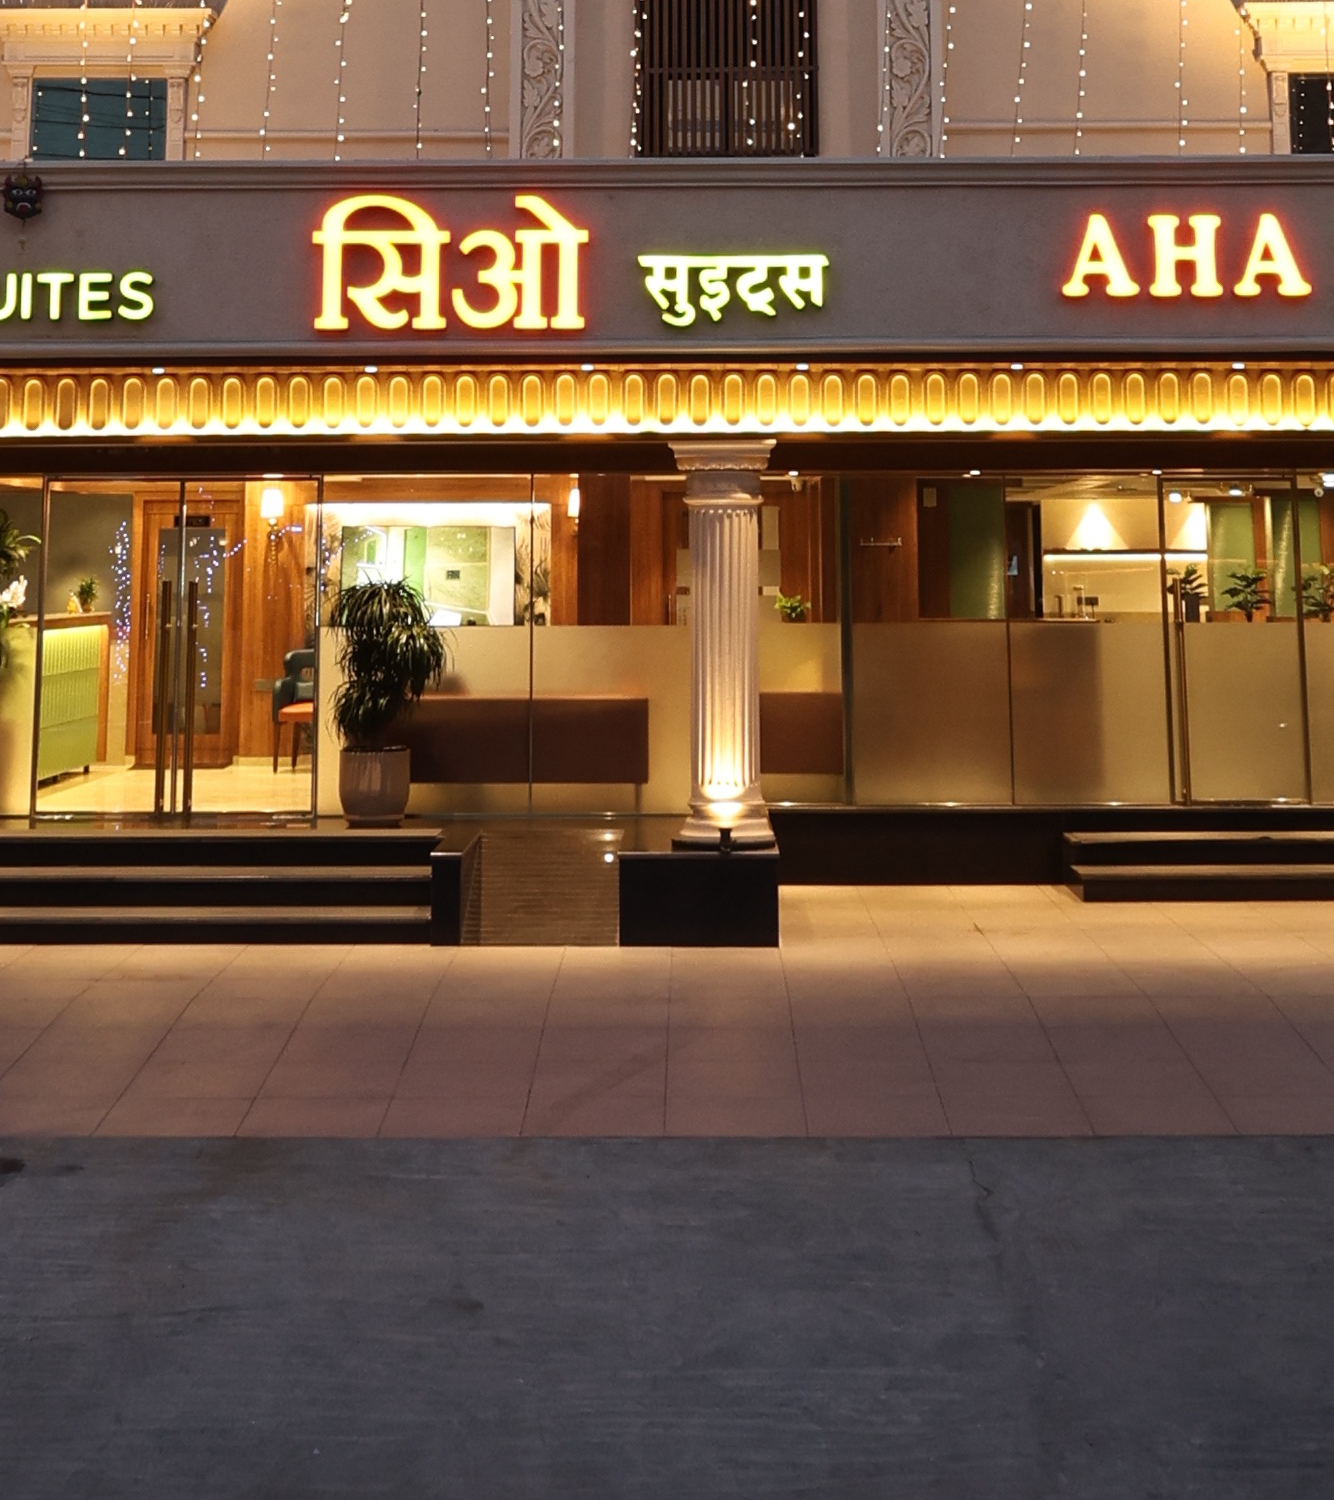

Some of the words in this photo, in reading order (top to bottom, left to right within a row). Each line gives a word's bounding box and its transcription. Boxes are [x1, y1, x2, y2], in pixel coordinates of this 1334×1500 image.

[312, 194, 589, 331] सिओ
[638, 254, 830, 327] सुइट्स
[1061, 213, 1313, 298] AHA
